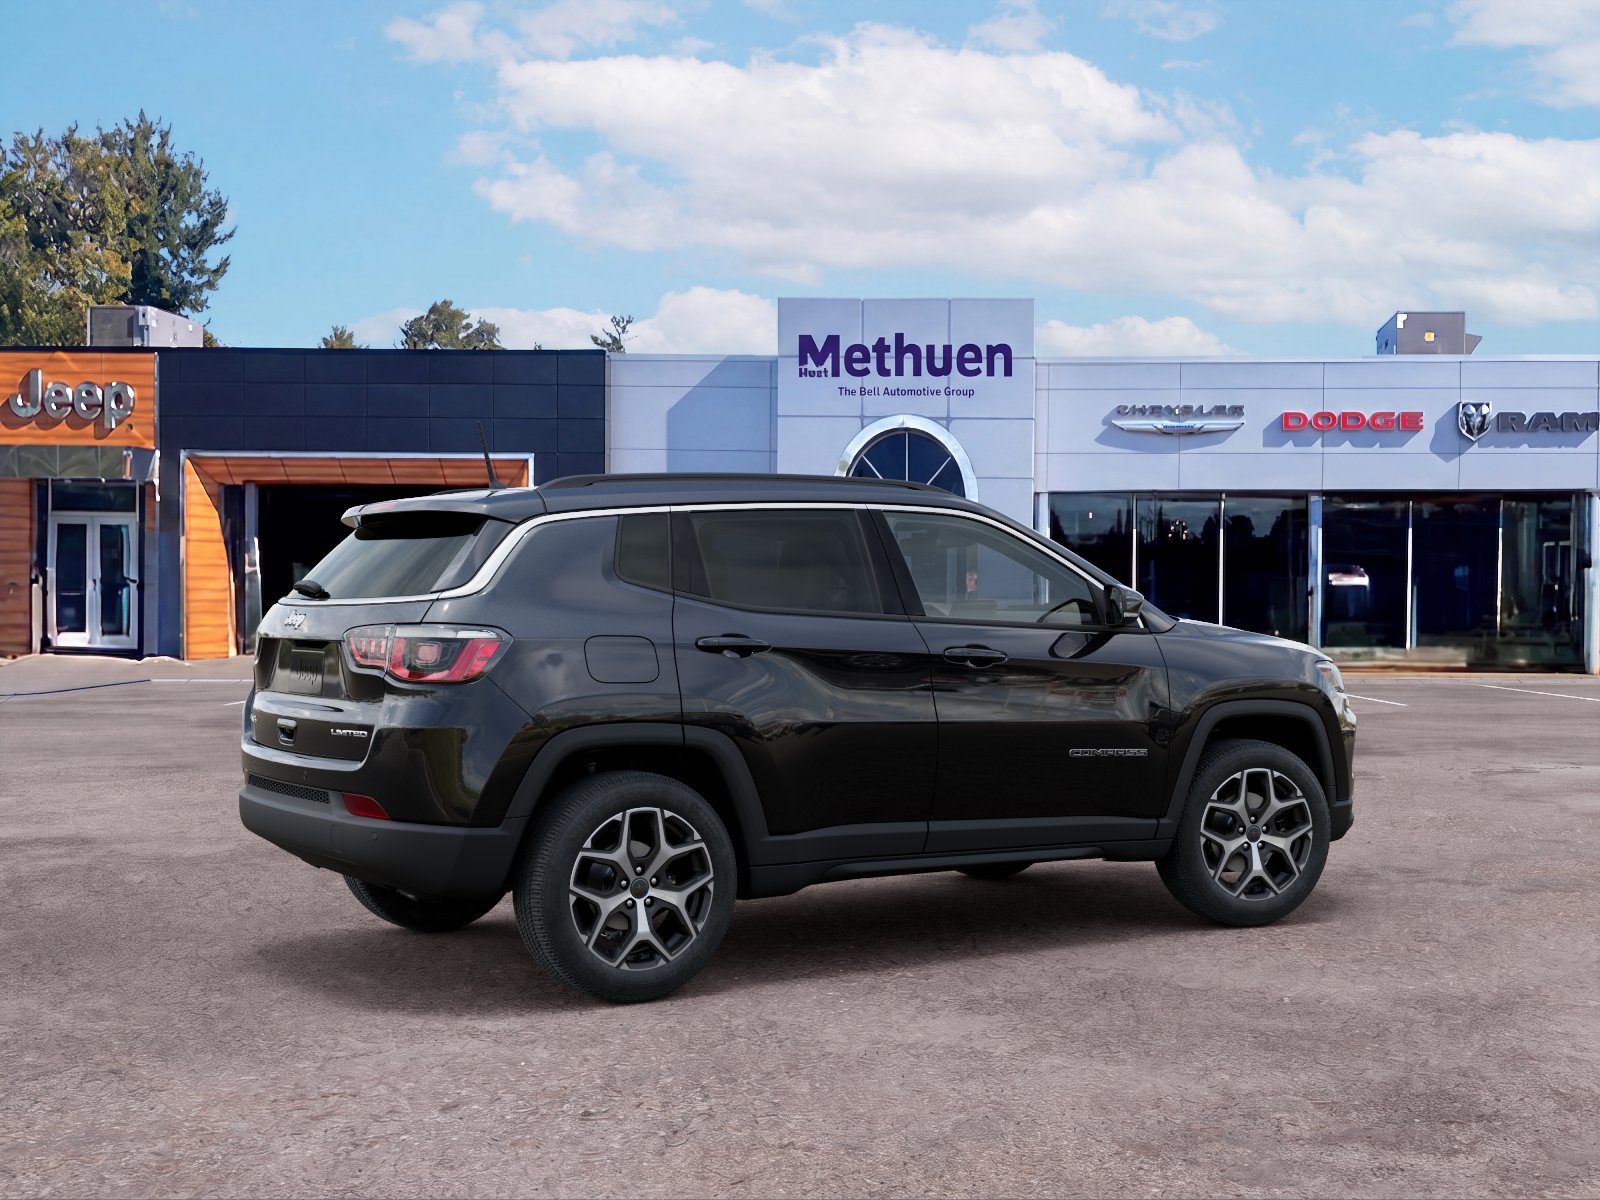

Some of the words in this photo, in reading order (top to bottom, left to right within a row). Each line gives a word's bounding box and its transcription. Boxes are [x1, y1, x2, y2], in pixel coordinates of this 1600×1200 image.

[798, 332, 1013, 378] Methuen
[9, 368, 136, 429] Jeep
[838, 386, 857, 397] The
[860, 386, 880, 397] Bell
[883, 386, 942, 397] Automotive
[944, 386, 975, 398] Group
[1282, 411, 1424, 430] DODGE
[1497, 411, 1600, 432] RAM
[330, 728, 368, 738] LIMITED
[1069, 748, 1148, 757] COMPASS
